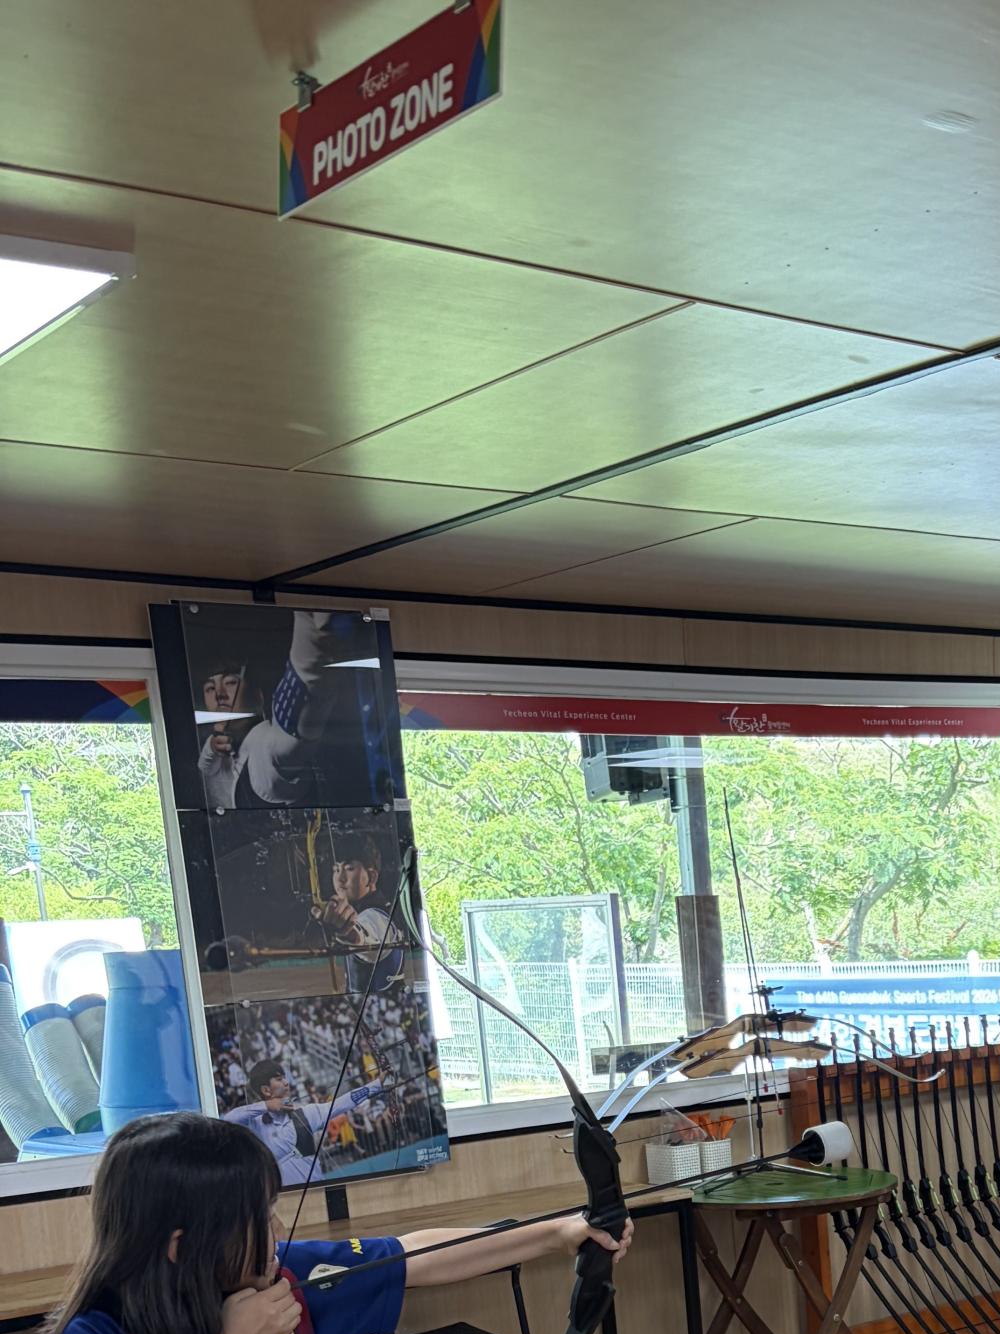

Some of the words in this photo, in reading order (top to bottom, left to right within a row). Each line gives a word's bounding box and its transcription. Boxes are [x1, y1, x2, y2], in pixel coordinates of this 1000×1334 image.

[312, 106, 386, 187] PHOTO
[389, 62, 454, 142] ZONE
[502, 709, 538, 718] Yecheon
[540, 710, 561, 719] Vital
[563, 711, 609, 720] Experience
[610, 712, 637, 721] Center
[908, 718, 941, 727] Experience
[943, 718, 964, 726] Center
[797, 991, 815, 1003] The
[893, 989, 927, 1004] Sports
[928, 989, 970, 1004] Festival
